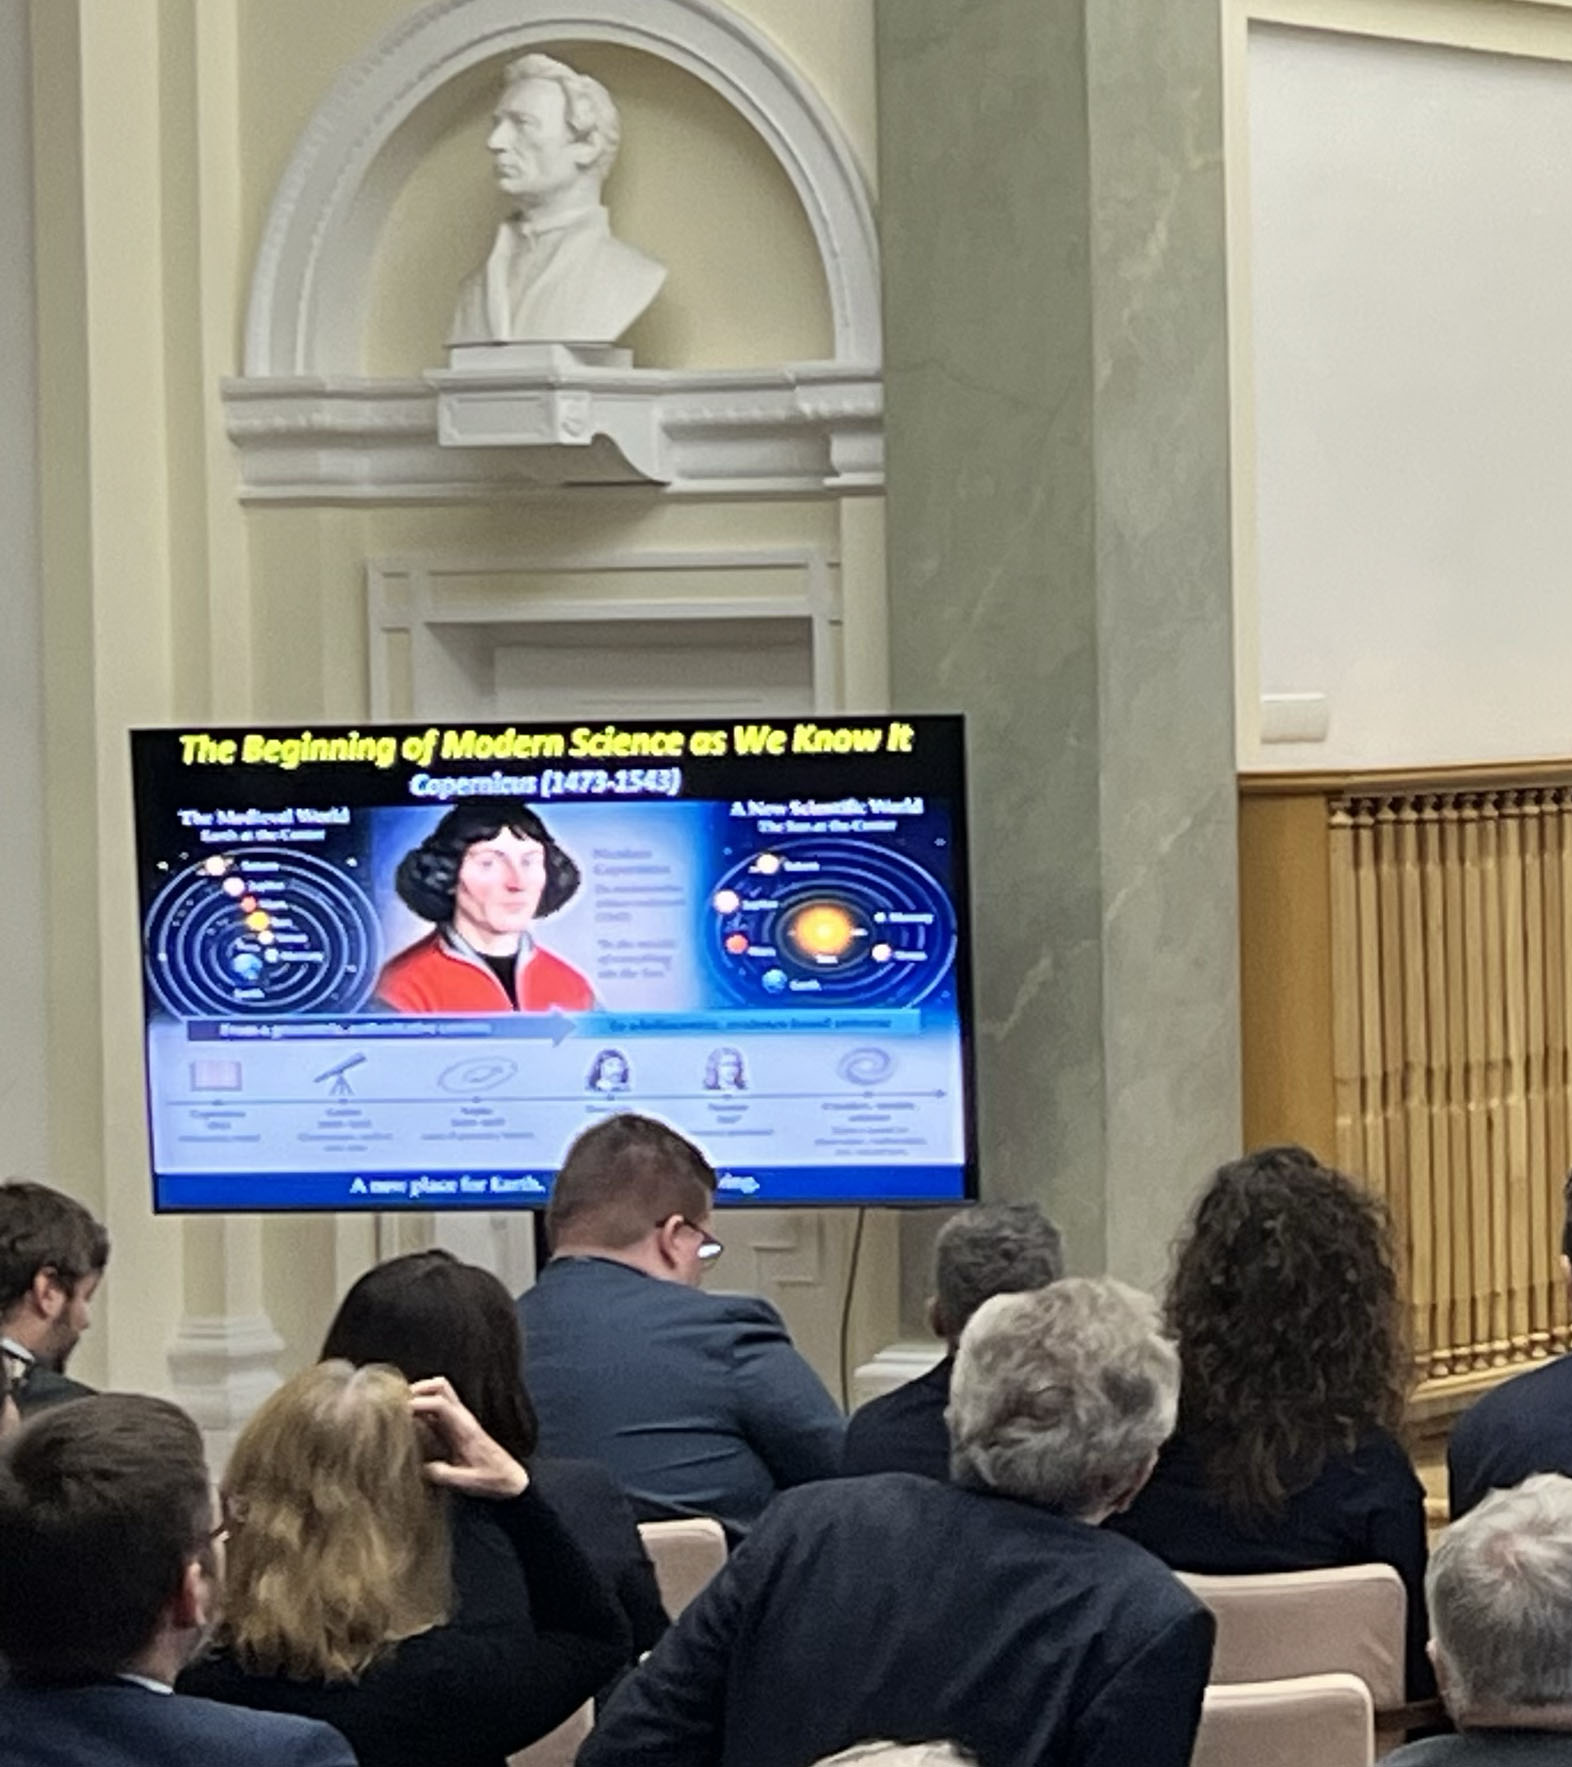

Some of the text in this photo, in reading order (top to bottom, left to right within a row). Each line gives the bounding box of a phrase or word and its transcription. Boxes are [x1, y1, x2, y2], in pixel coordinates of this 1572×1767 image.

[180, 722, 914, 769] The Beginning of Modern Science as We Know It
[409, 767, 682, 800] Copernicus (1473-1543)
[350, 1176, 368, 1194] A
[370, 1180, 407, 1194] new
[409, 1175, 458, 1198] place
[460, 1174, 488, 1194] for
